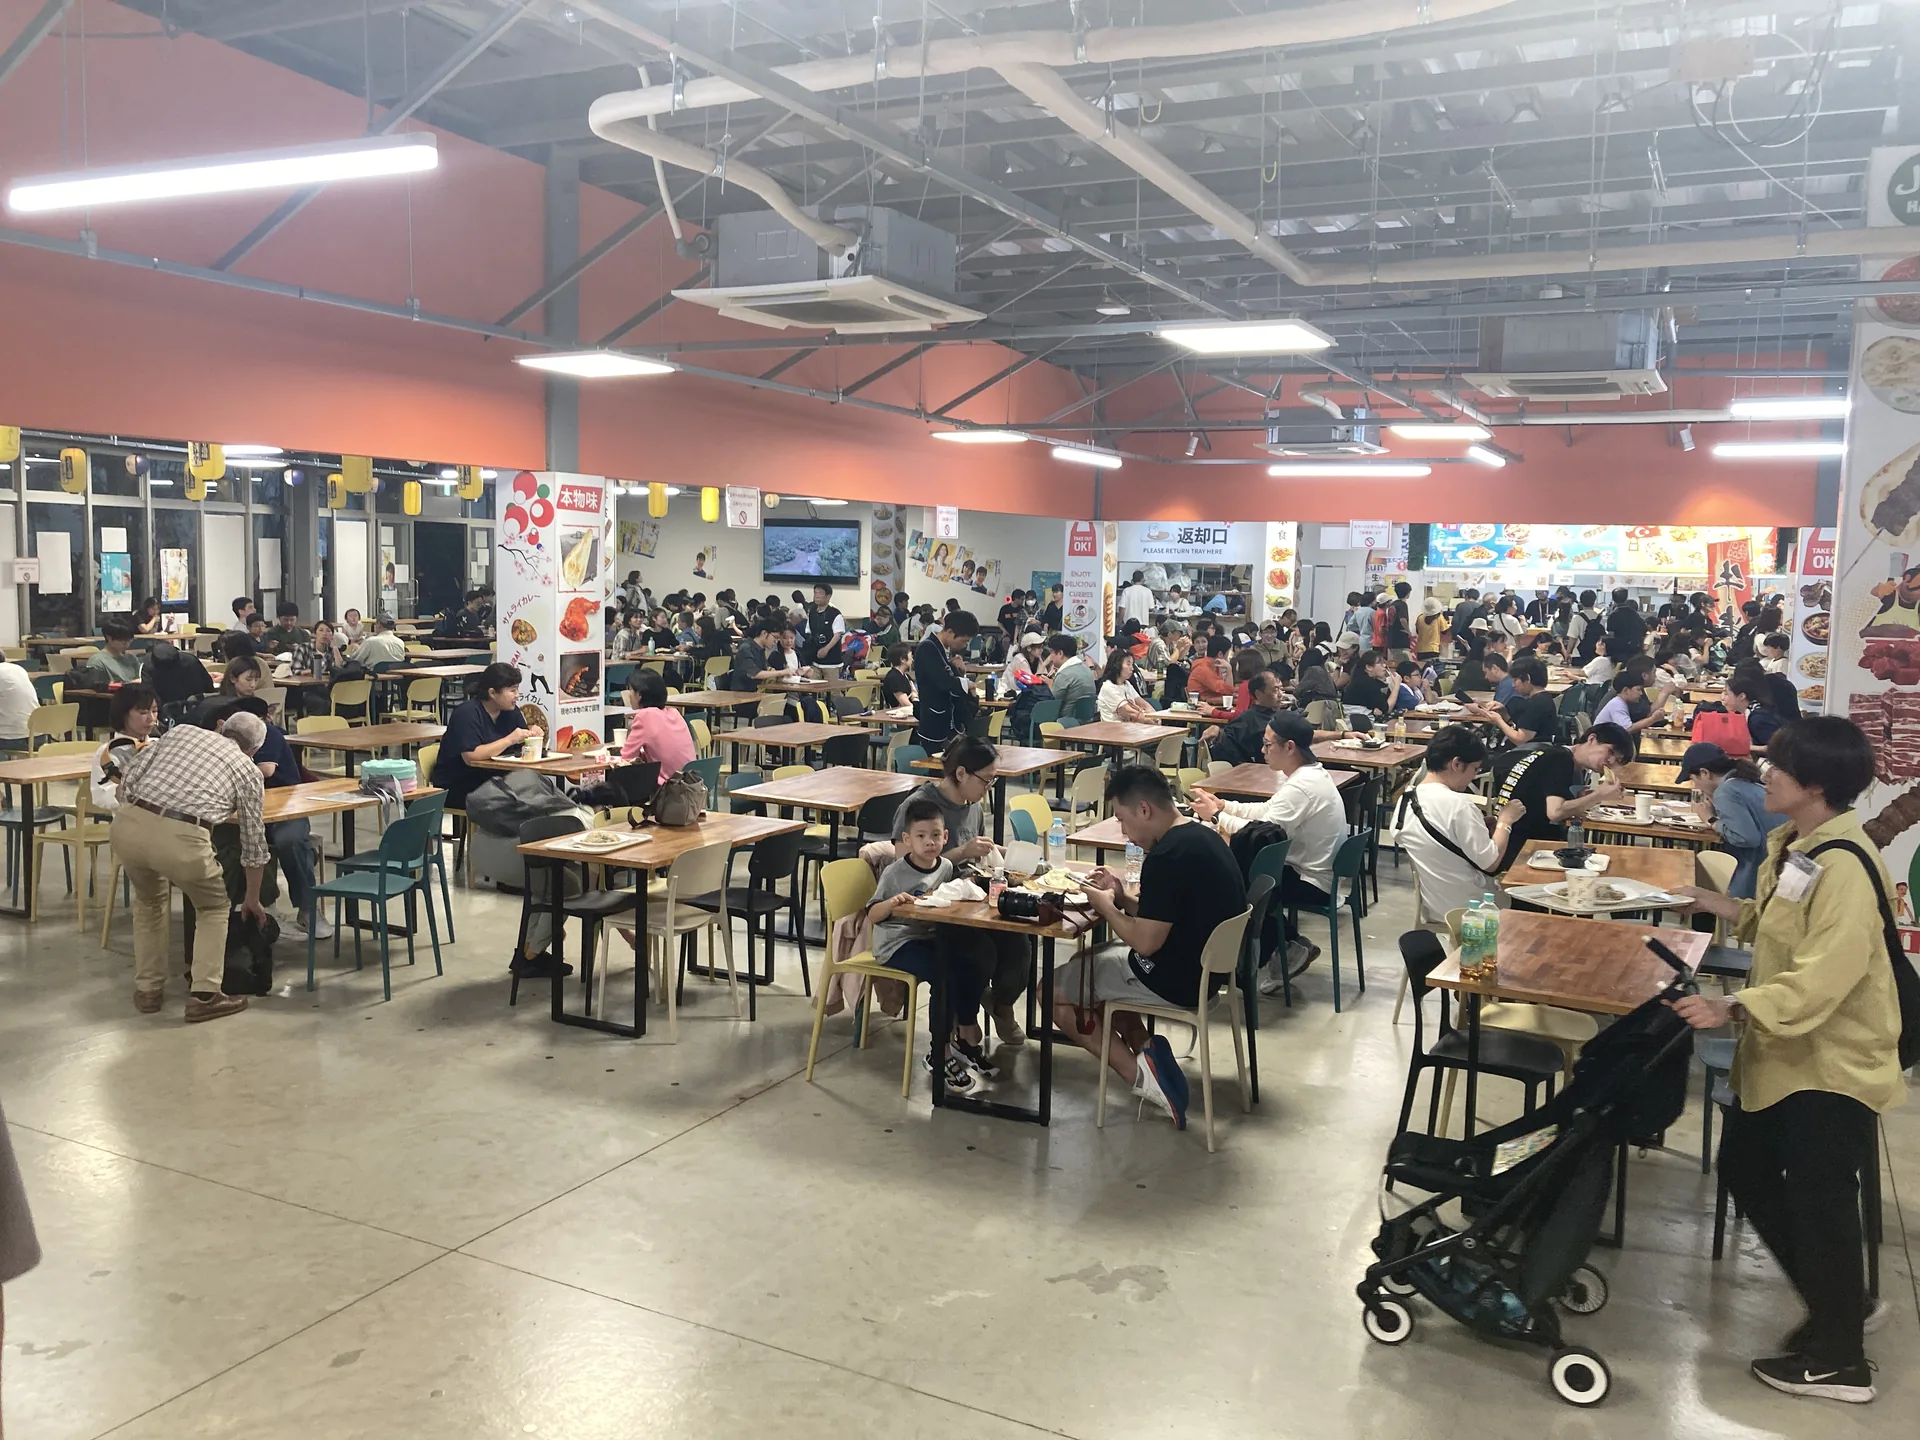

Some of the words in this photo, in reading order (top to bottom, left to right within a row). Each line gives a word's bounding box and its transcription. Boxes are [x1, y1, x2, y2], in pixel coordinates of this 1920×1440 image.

[1907, 200, 1920, 213] H
[560, 488, 598, 509] 本物味
[1177, 527, 1228, 544] 返却口
[1074, 541, 1091, 552] OK!
[502, 593, 541, 625] サムライカレー
